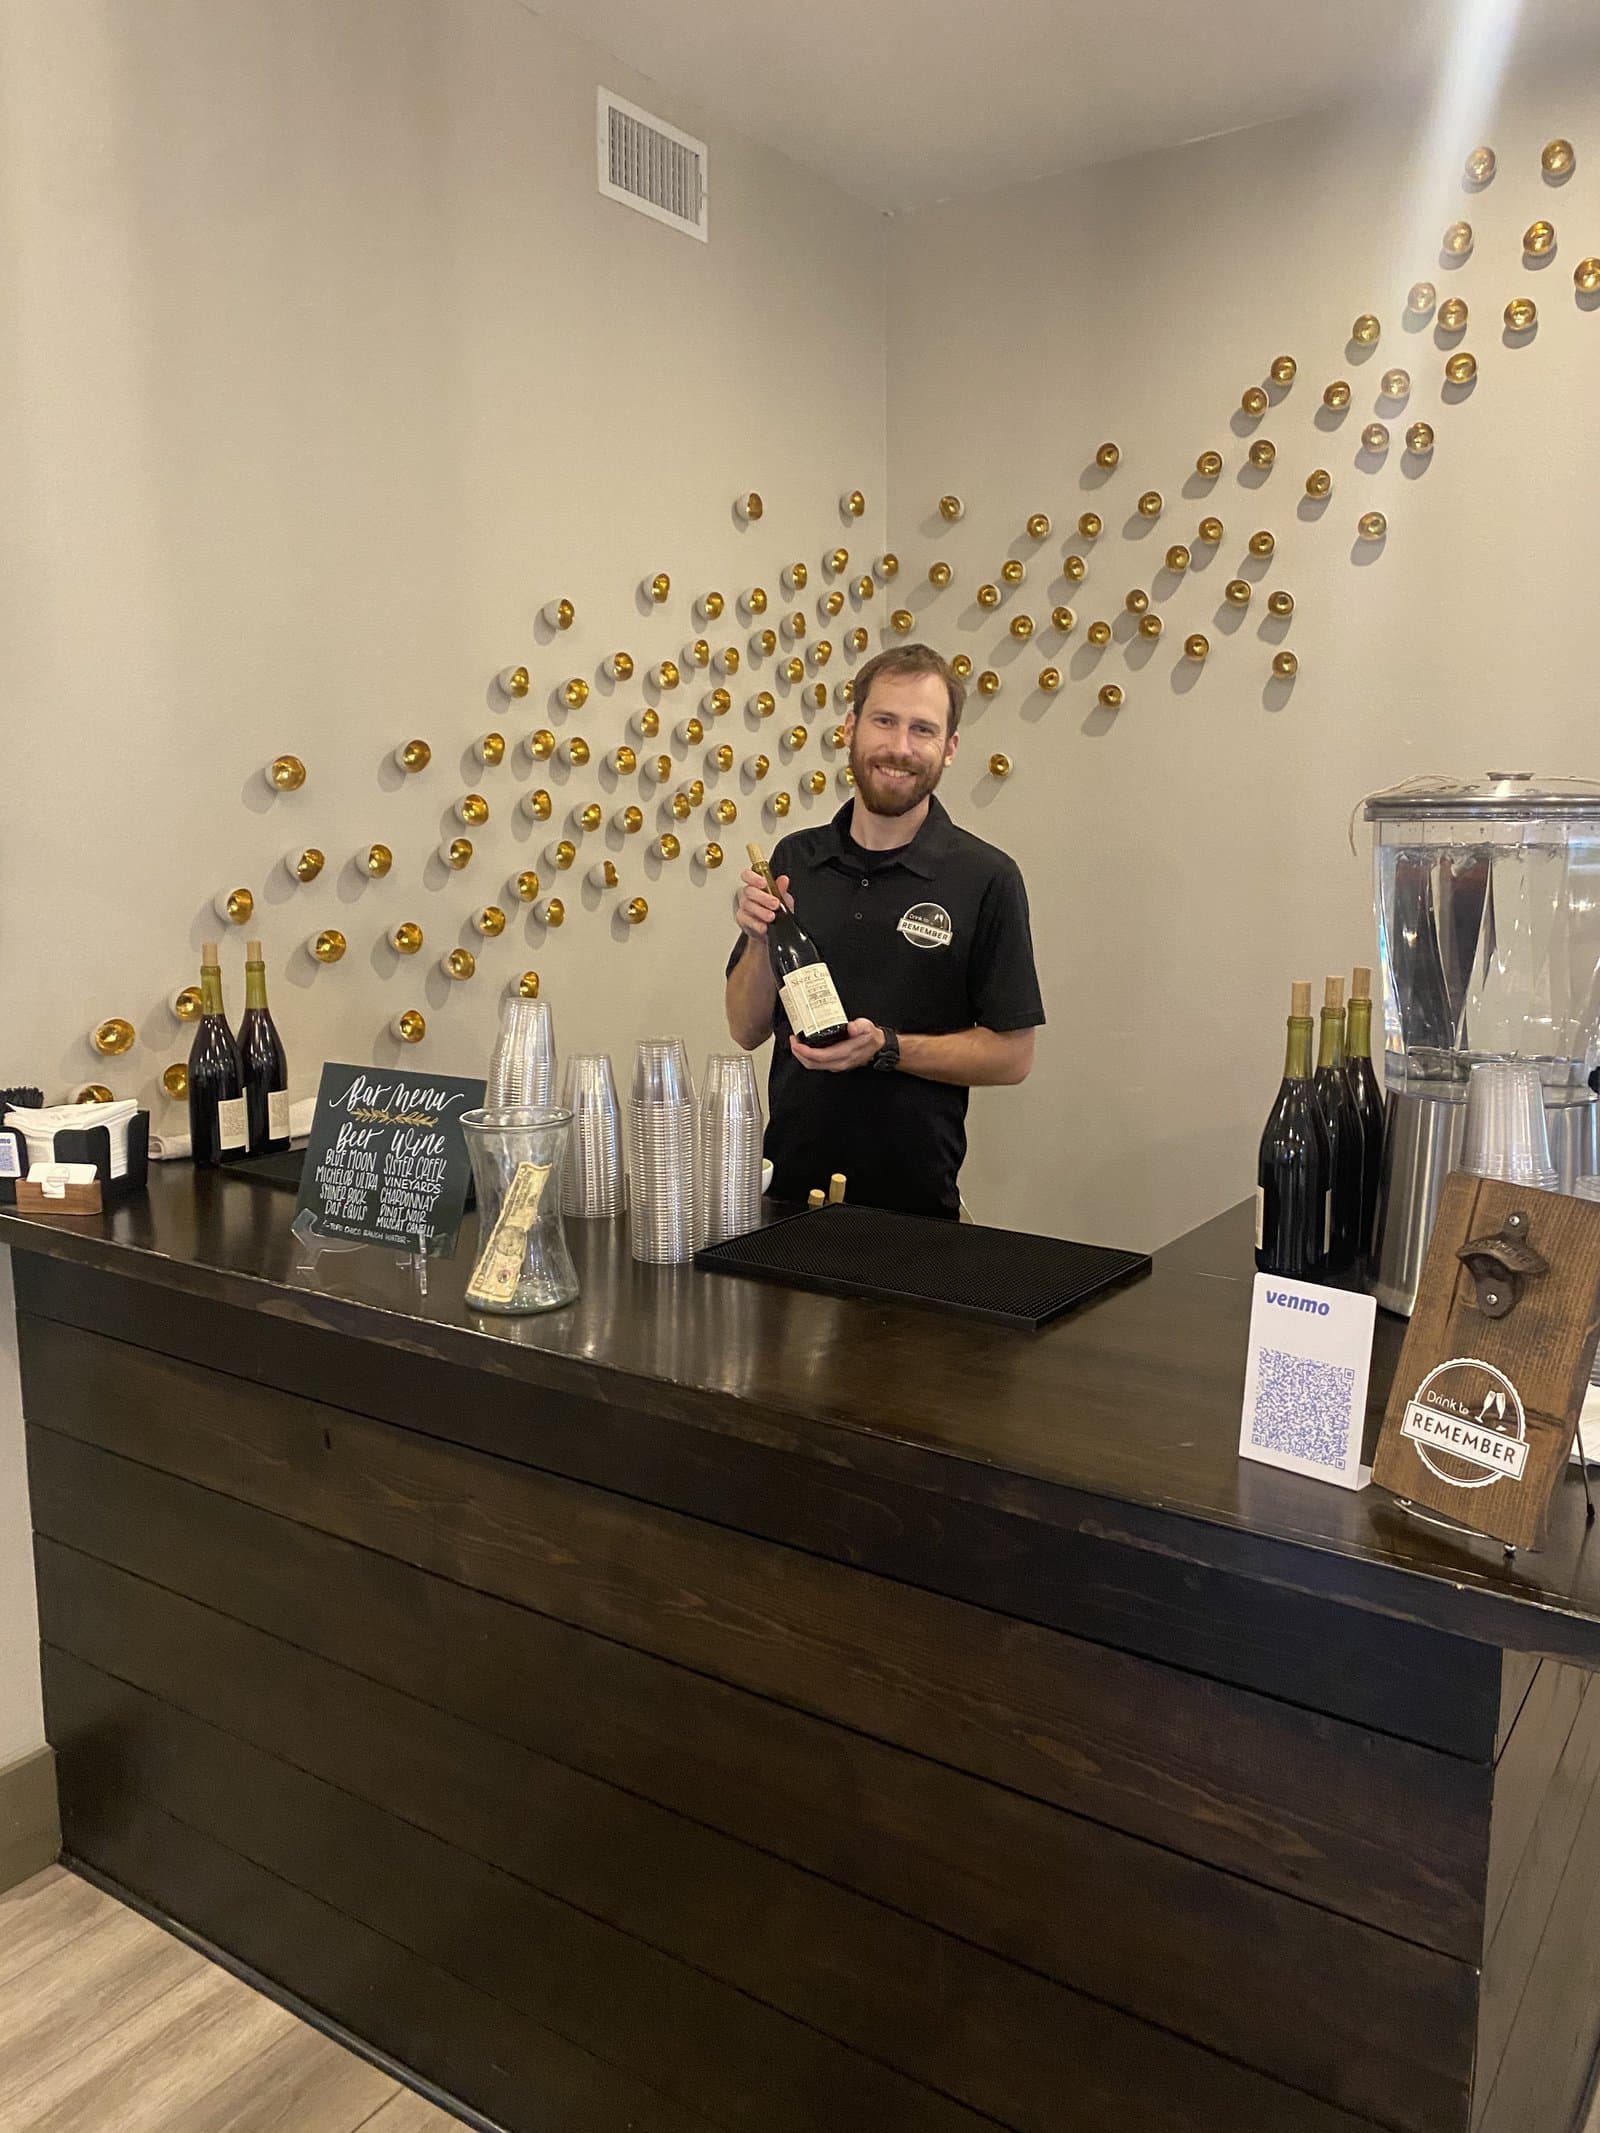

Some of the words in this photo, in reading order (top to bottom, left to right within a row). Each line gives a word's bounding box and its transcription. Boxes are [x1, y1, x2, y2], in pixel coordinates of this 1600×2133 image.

[901, 921, 949, 941] REMEMBER
[329, 1075, 392, 1112] Bar
[336, 1122, 385, 1153] Beer
[391, 1127, 446, 1159] Wine
[325, 1148, 348, 1168] BLUE
[347, 1149, 378, 1173] MOON
[383, 1153, 413, 1178] SISTER
[415, 1156, 447, 1183] CREEK
[315, 1165, 355, 1187] MICHELOB
[355, 1171, 379, 1191] ULTRA
[320, 1183, 347, 1201] SHINER
[346, 1187, 368, 1205] BOCK
[380, 1187, 440, 1212] CHARDONNAY
[325, 1200, 342, 1216] DOS
[342, 1202, 368, 1221] EQUIS
[379, 1203, 405, 1220] PINOT
[404, 1208, 428, 1223] NOIR
[375, 1216, 406, 1232] MUSCAT
[1266, 1290, 1330, 1316] venmo
[1427, 1390, 1457, 1411] Drink
[1458, 1402, 1470, 1415] to
[1412, 1412, 1516, 1464] REMEMBER
